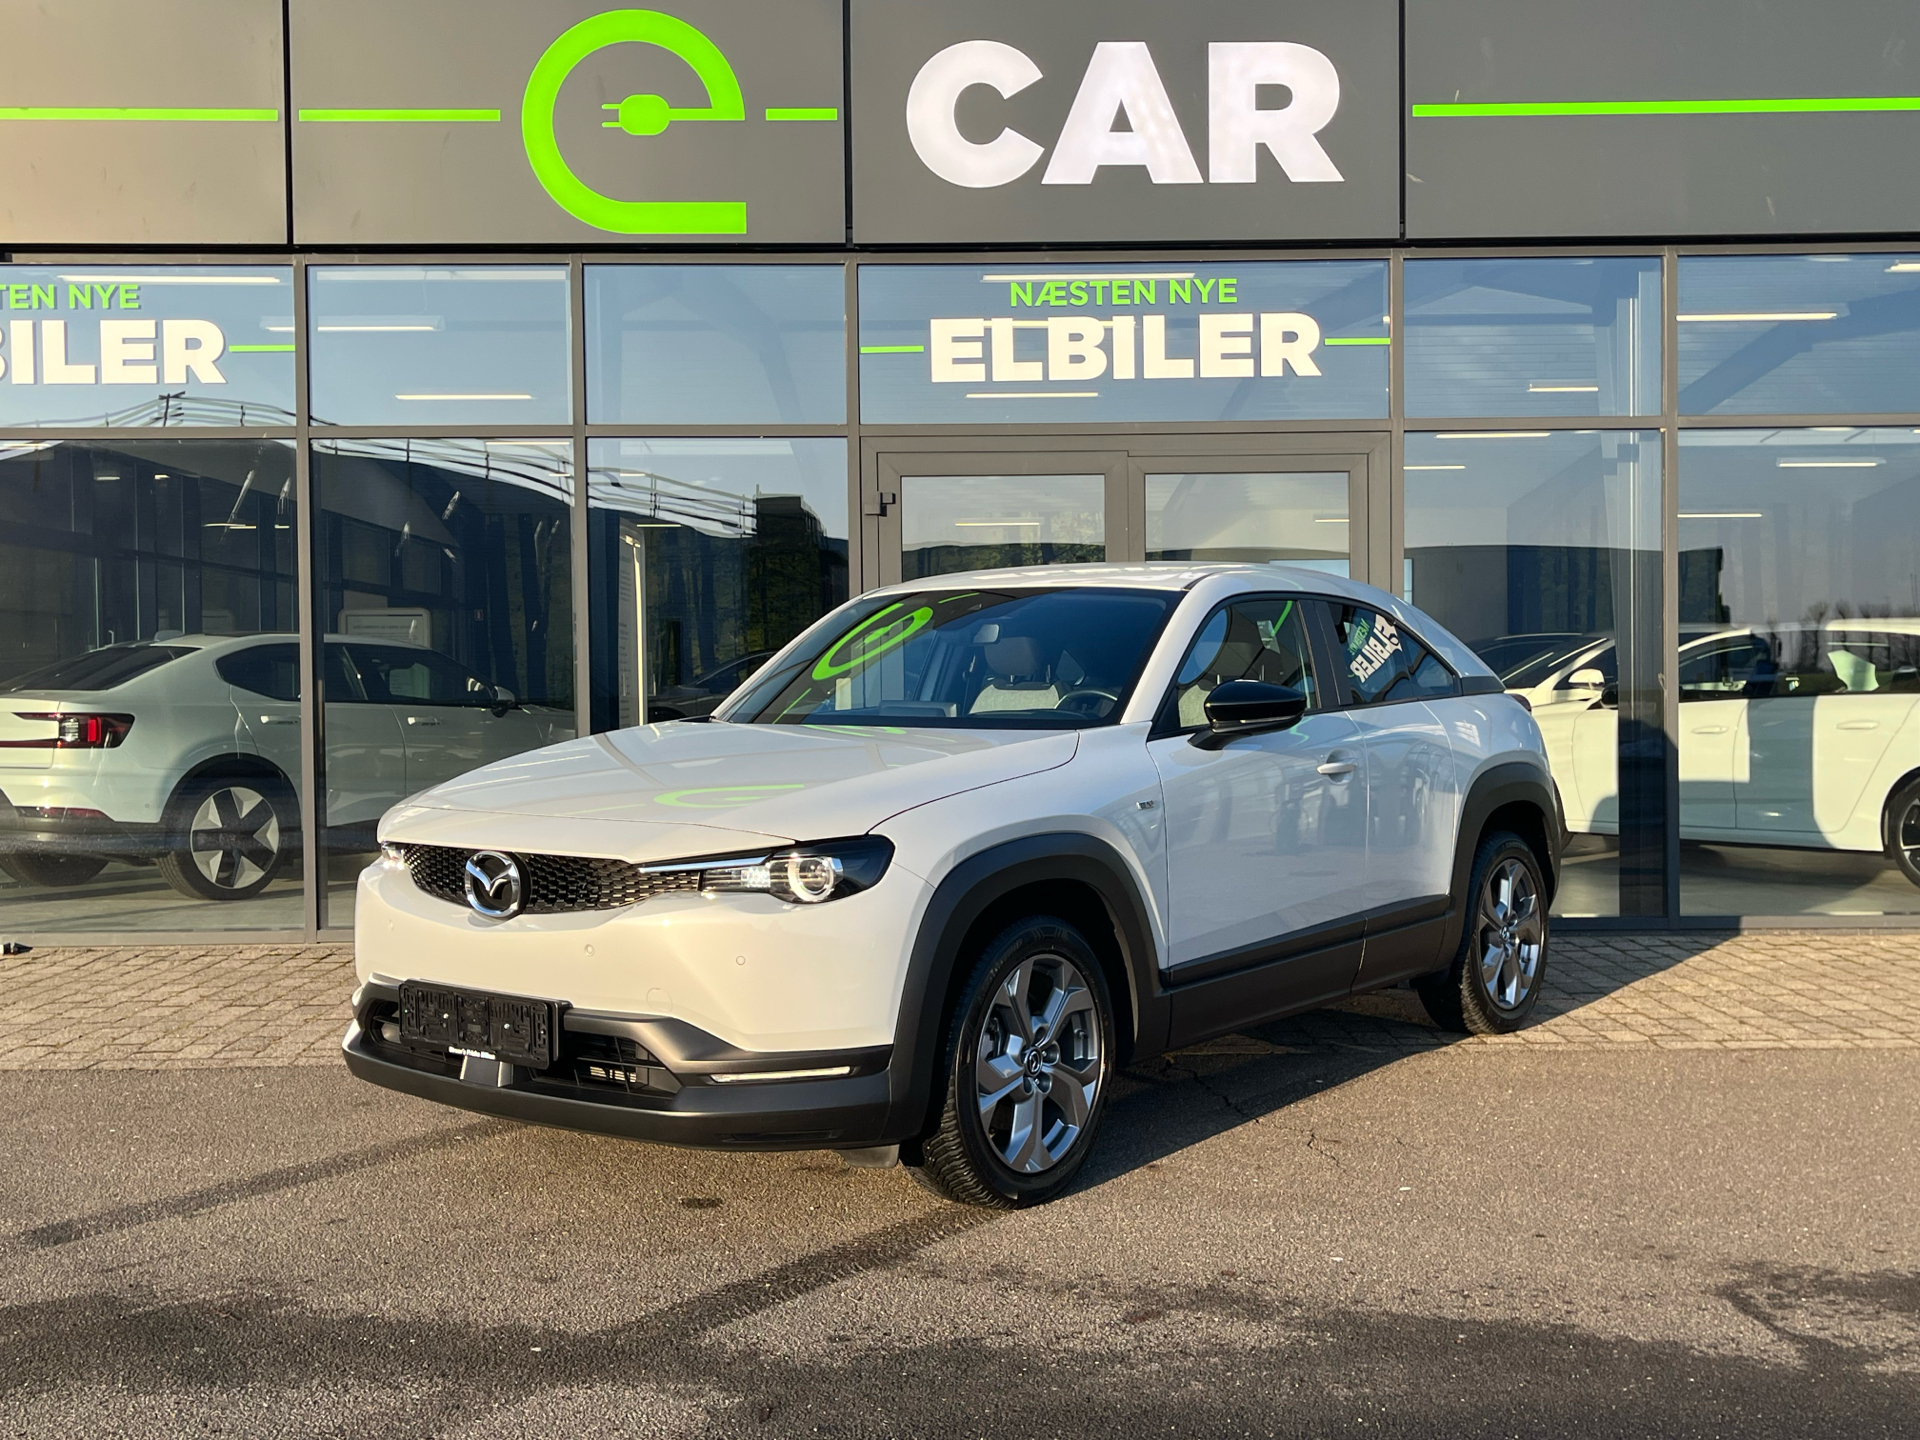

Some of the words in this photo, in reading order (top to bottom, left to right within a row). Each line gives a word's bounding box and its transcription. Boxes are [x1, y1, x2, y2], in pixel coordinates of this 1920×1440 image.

[906, 39, 1345, 188] CAR
[68, 283, 140, 310] NYE
[1009, 279, 1156, 308] NÆSTEN
[1168, 278, 1239, 305] NYE
[0, 319, 227, 384] ILER
[929, 312, 1322, 384] ELBILER
